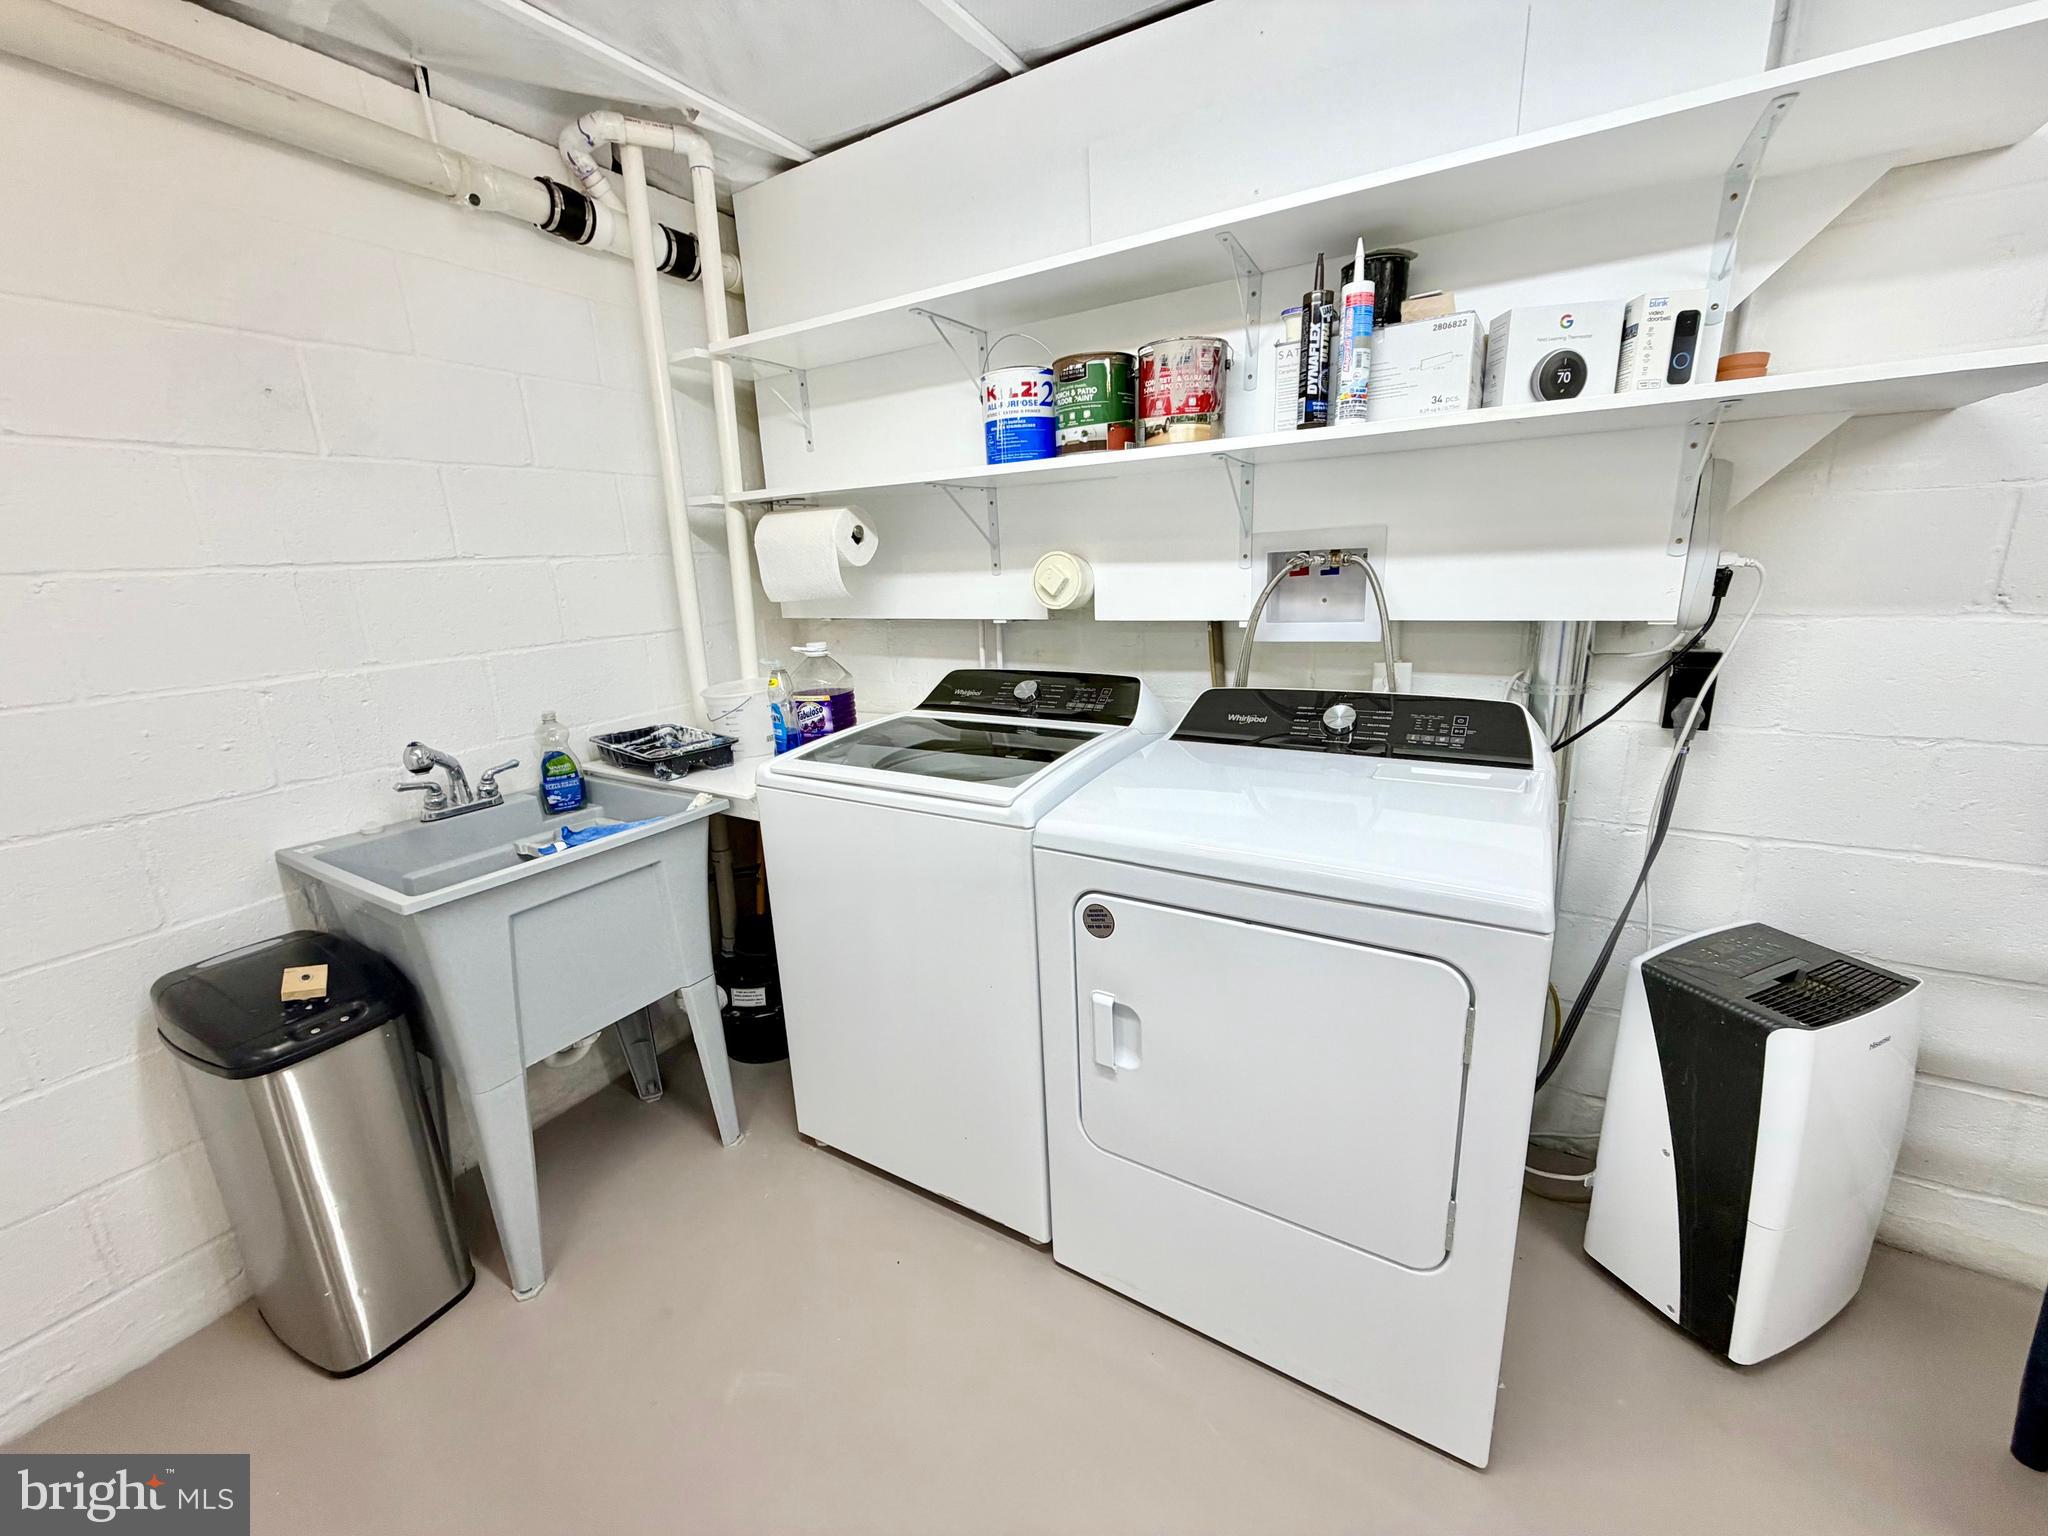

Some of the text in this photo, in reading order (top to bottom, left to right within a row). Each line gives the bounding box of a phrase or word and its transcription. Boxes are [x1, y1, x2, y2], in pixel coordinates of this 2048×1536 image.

[1649, 299, 1669, 308] blink
[1432, 319, 1468, 332] 2806822
[1560, 313, 1574, 329] G
[1306, 322, 1321, 395] DYNAFLEX
[1557, 371, 1571, 384] 70
[1077, 386, 1098, 396] PATIO
[1431, 395, 1443, 404] 34
[955, 689, 982, 698] Whirlpool
[798, 706, 824, 721] Fabuloso
[1228, 714, 1268, 724] Whirlpool
